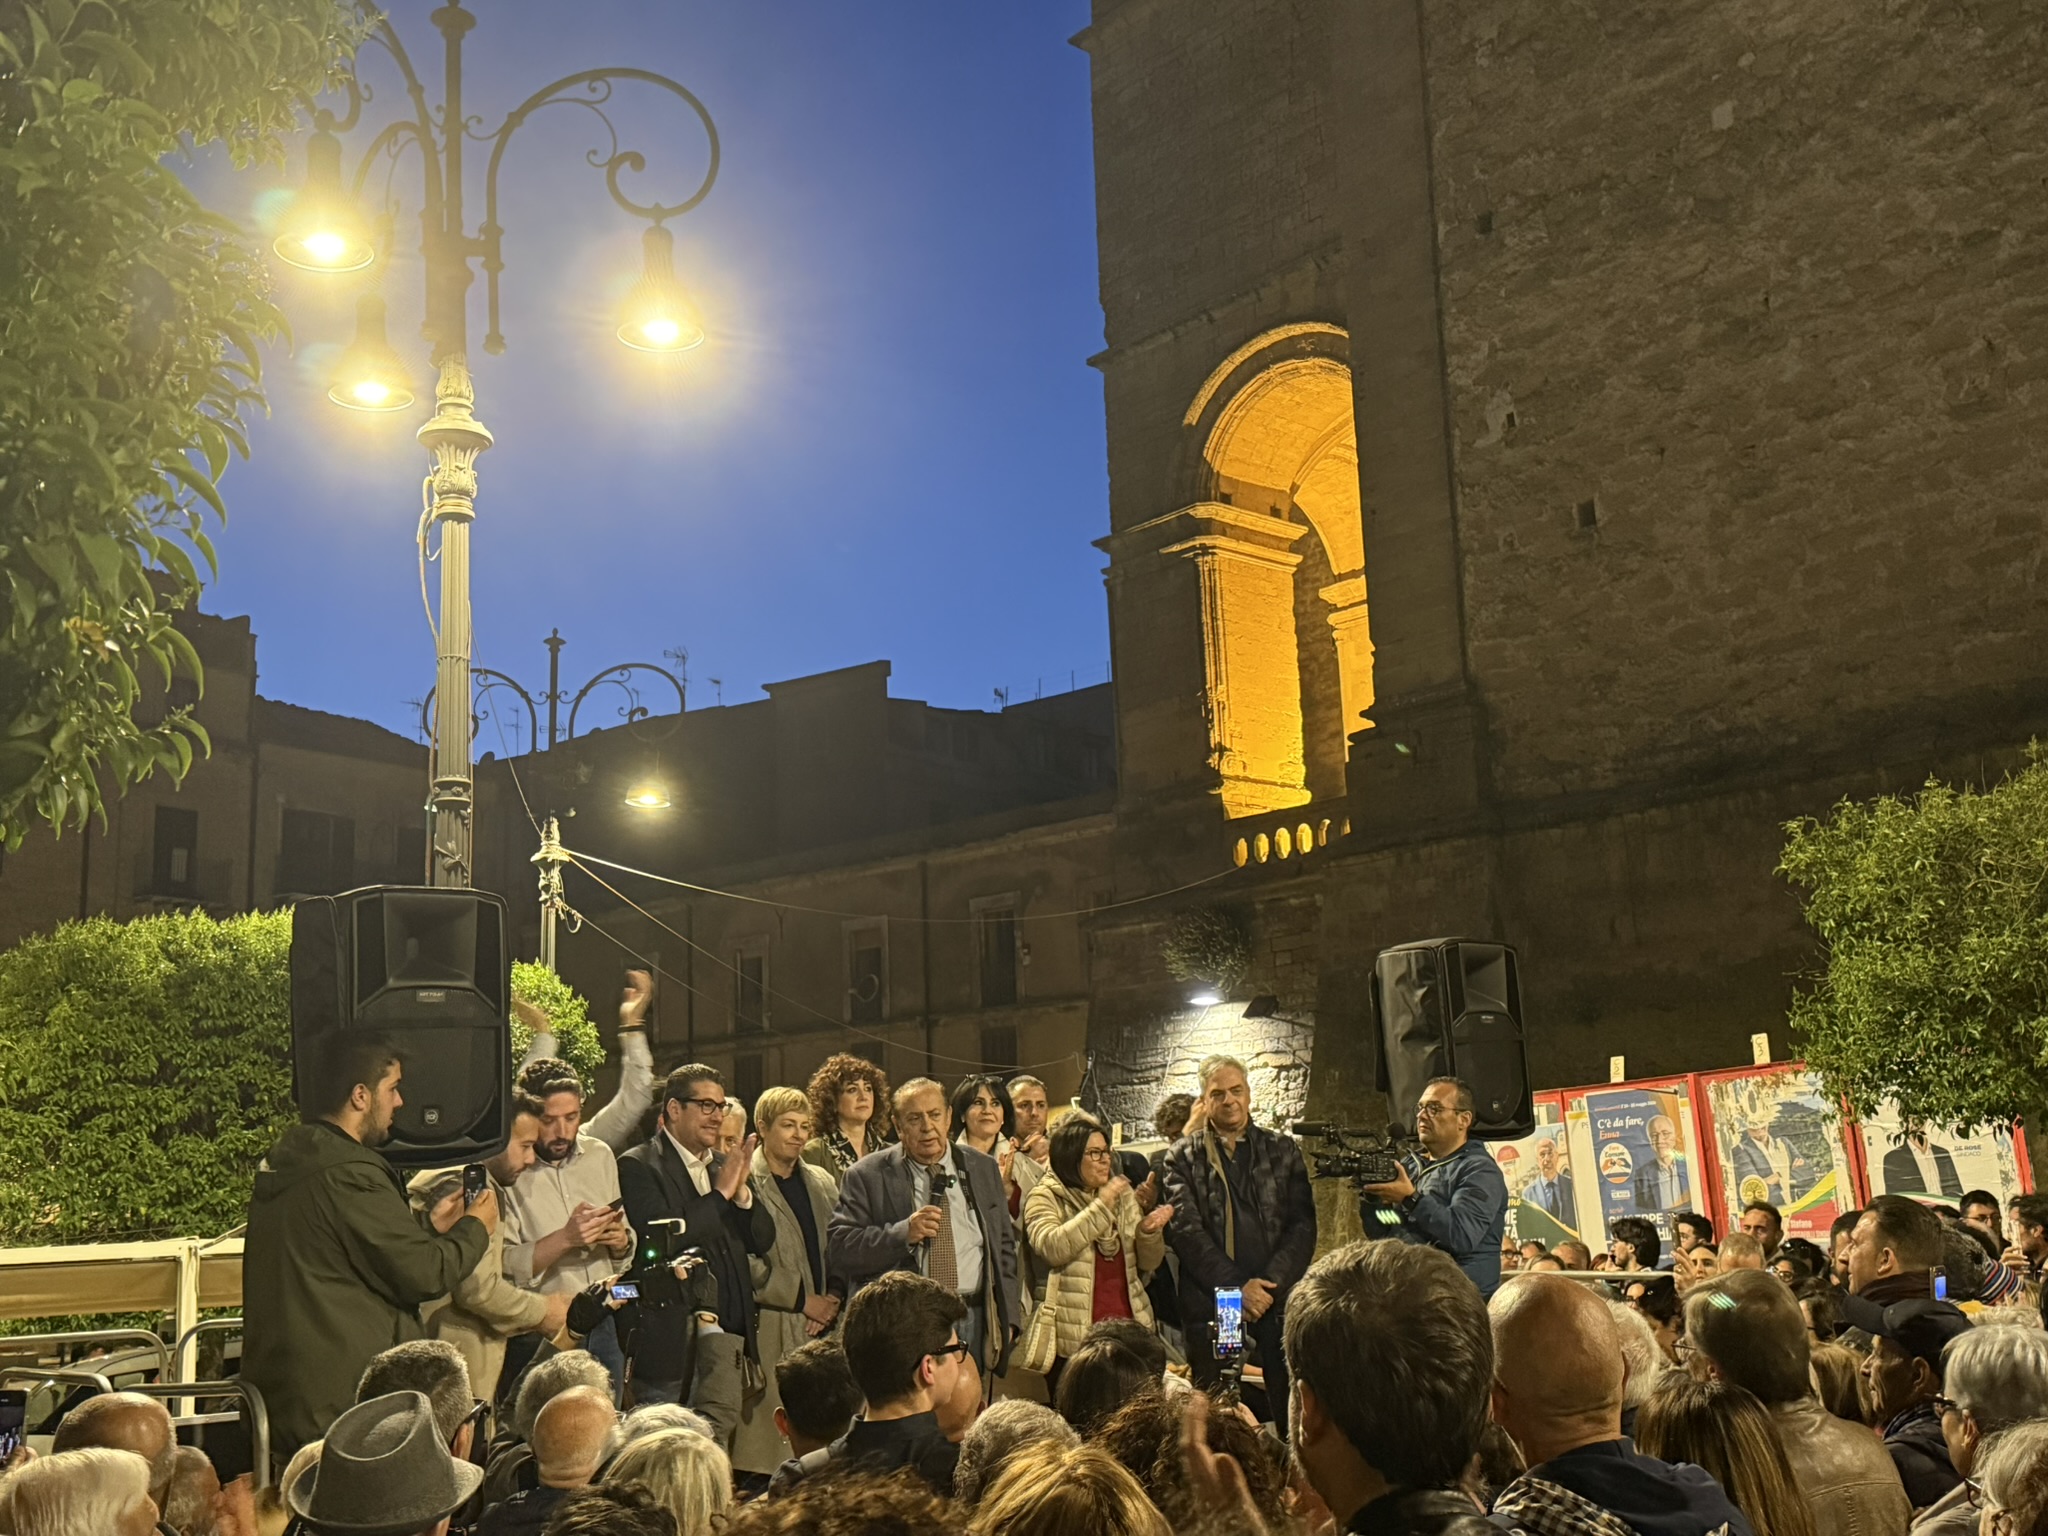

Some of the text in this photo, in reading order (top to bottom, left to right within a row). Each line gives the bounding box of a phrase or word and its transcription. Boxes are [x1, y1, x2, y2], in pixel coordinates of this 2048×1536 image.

[1597, 1118, 1612, 1130] C'è
[1613, 1117, 1625, 1128] da
[1625, 1115, 1644, 1129] fare,
